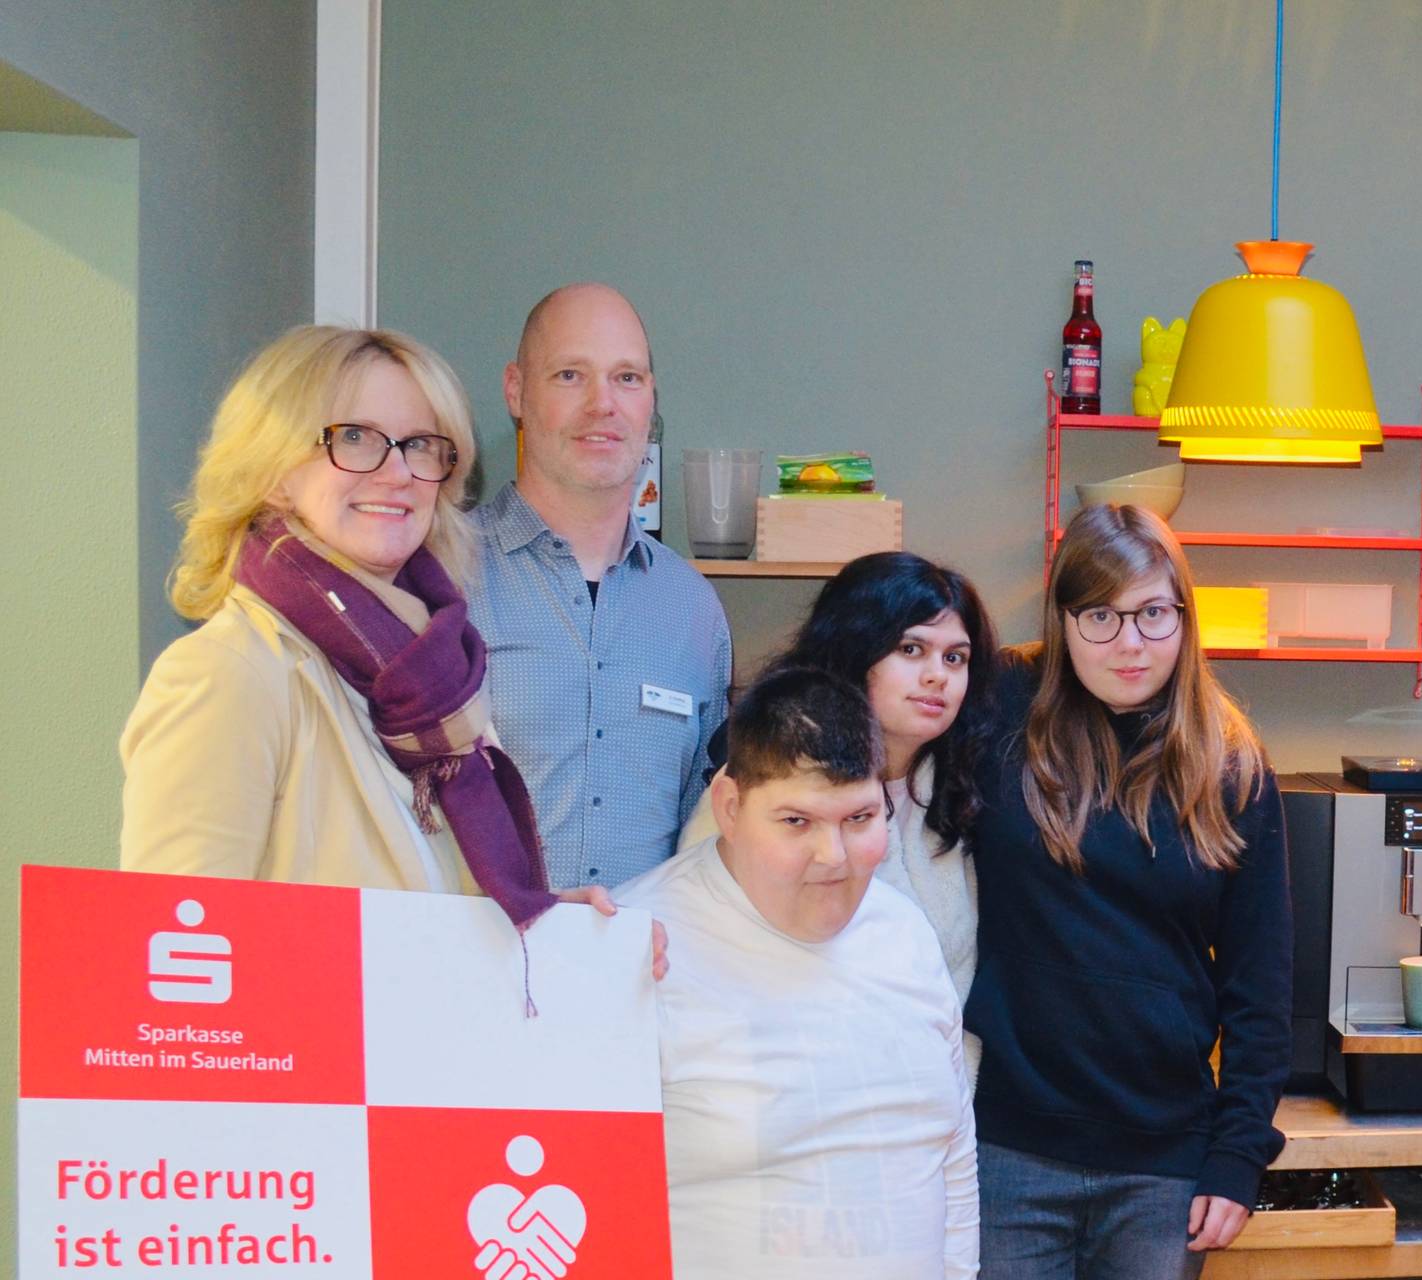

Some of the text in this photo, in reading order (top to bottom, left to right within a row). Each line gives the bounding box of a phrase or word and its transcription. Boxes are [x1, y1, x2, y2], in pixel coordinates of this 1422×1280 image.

[137, 1023, 244, 1045] Sparkasse
[85, 1048, 293, 1071] Mitten im Sauerland
[58, 1158, 315, 1211] Förderung
[54, 1223, 333, 1268] ist einfach.
